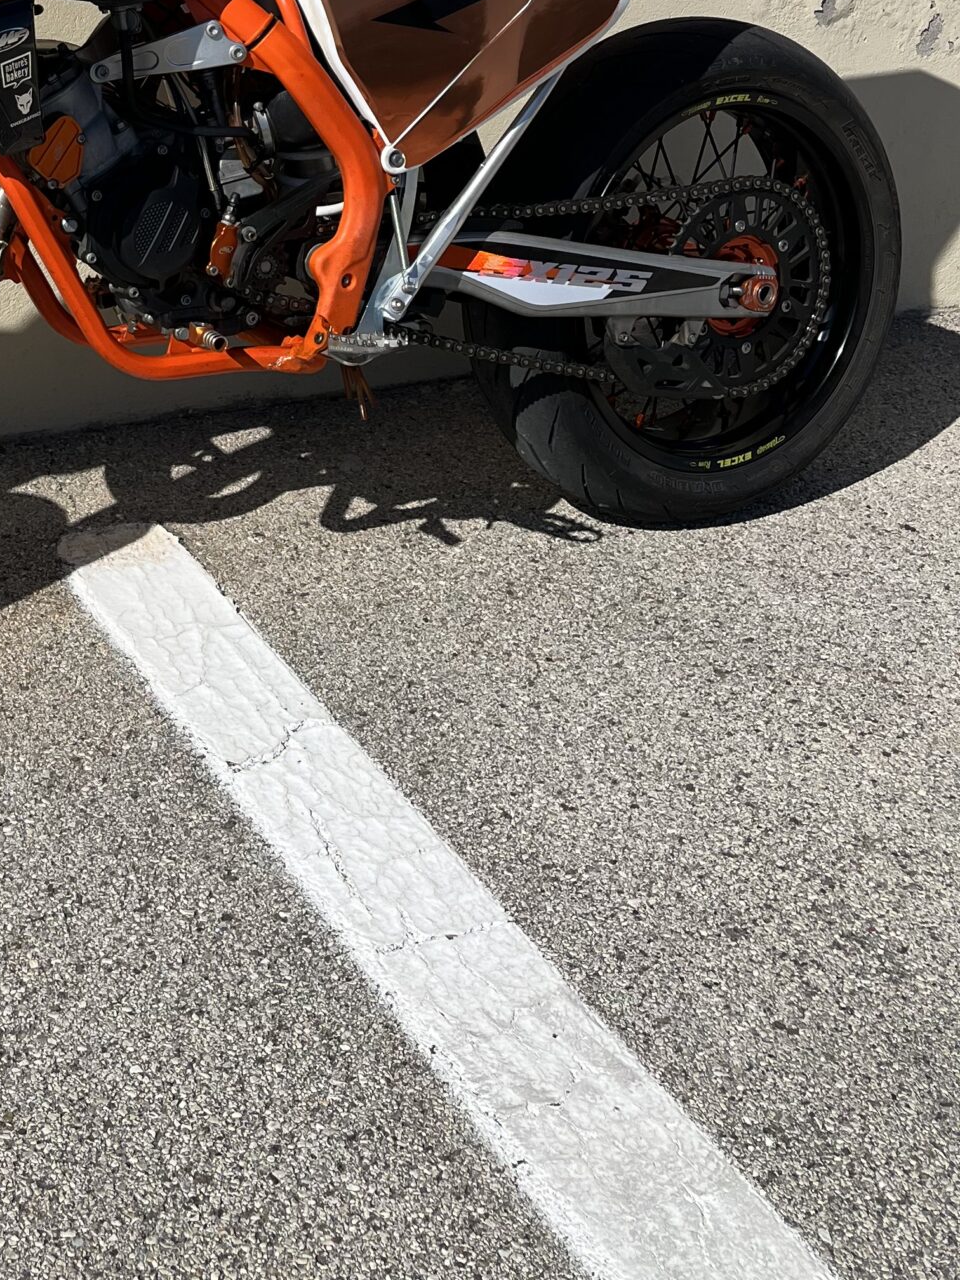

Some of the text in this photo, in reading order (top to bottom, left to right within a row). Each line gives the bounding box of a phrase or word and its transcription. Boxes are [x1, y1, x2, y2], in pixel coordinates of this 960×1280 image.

[4, 57, 29, 73] nature's
[5, 66, 30, 84] bakery
[715, 93, 752, 106] EXCEL
[477, 251, 655, 293] SX125
[716, 451, 754, 469] EXCEL
